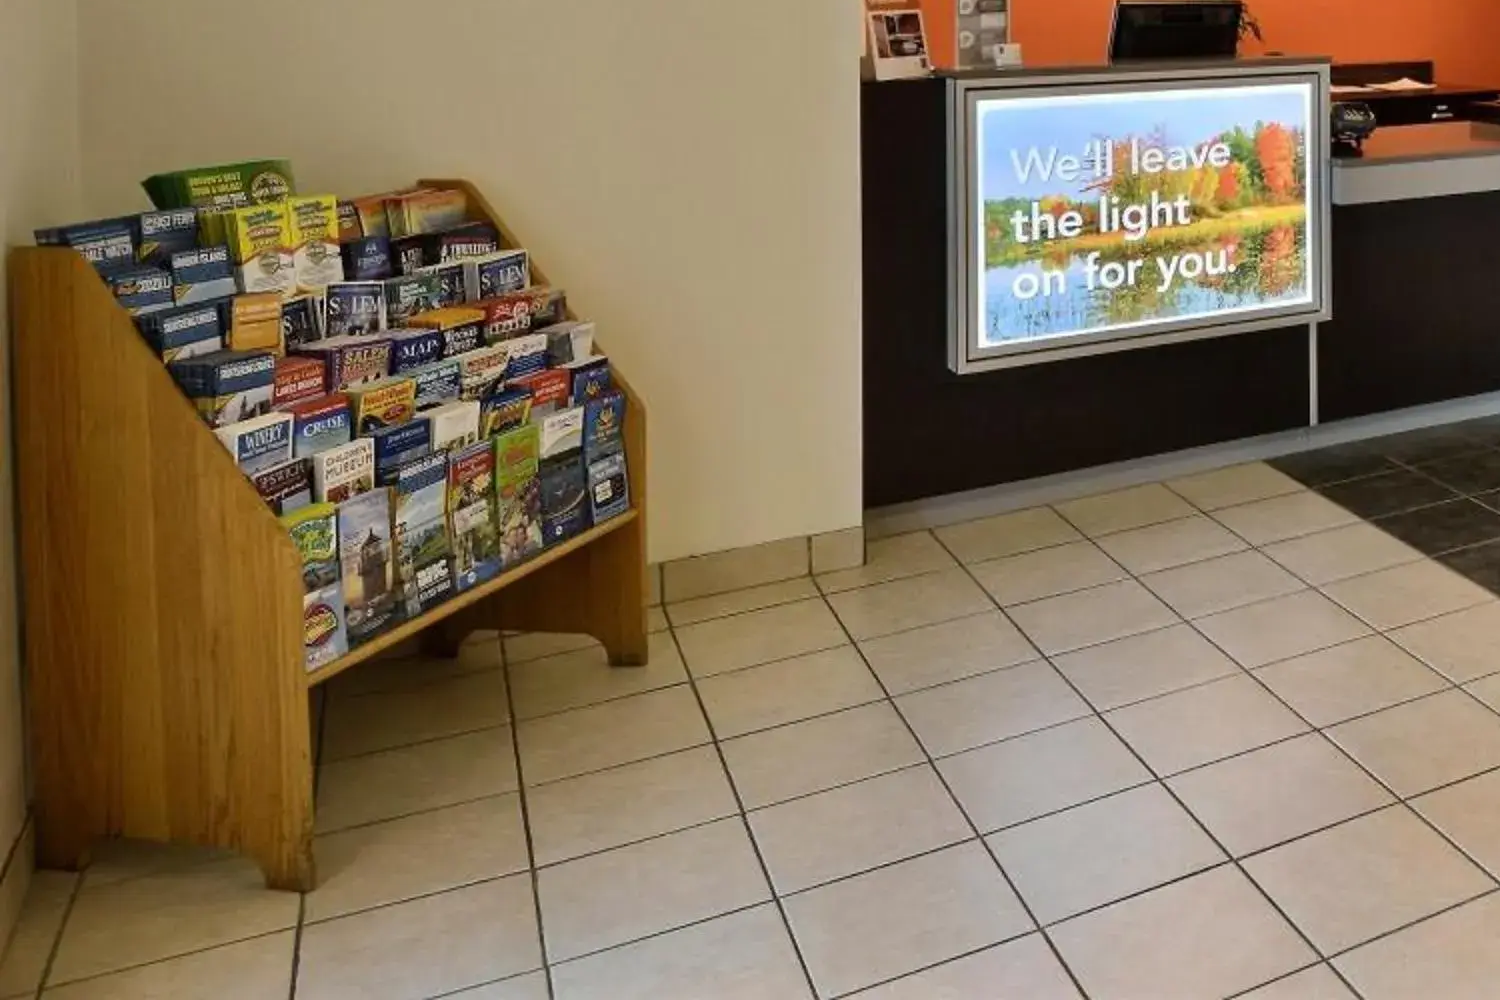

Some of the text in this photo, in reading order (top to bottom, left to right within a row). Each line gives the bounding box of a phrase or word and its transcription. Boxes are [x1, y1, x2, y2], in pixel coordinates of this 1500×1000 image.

[1010, 138, 1231, 184] We'll leave
[1010, 192, 1191, 244] the light
[1012, 247, 1236, 300] on for you.
